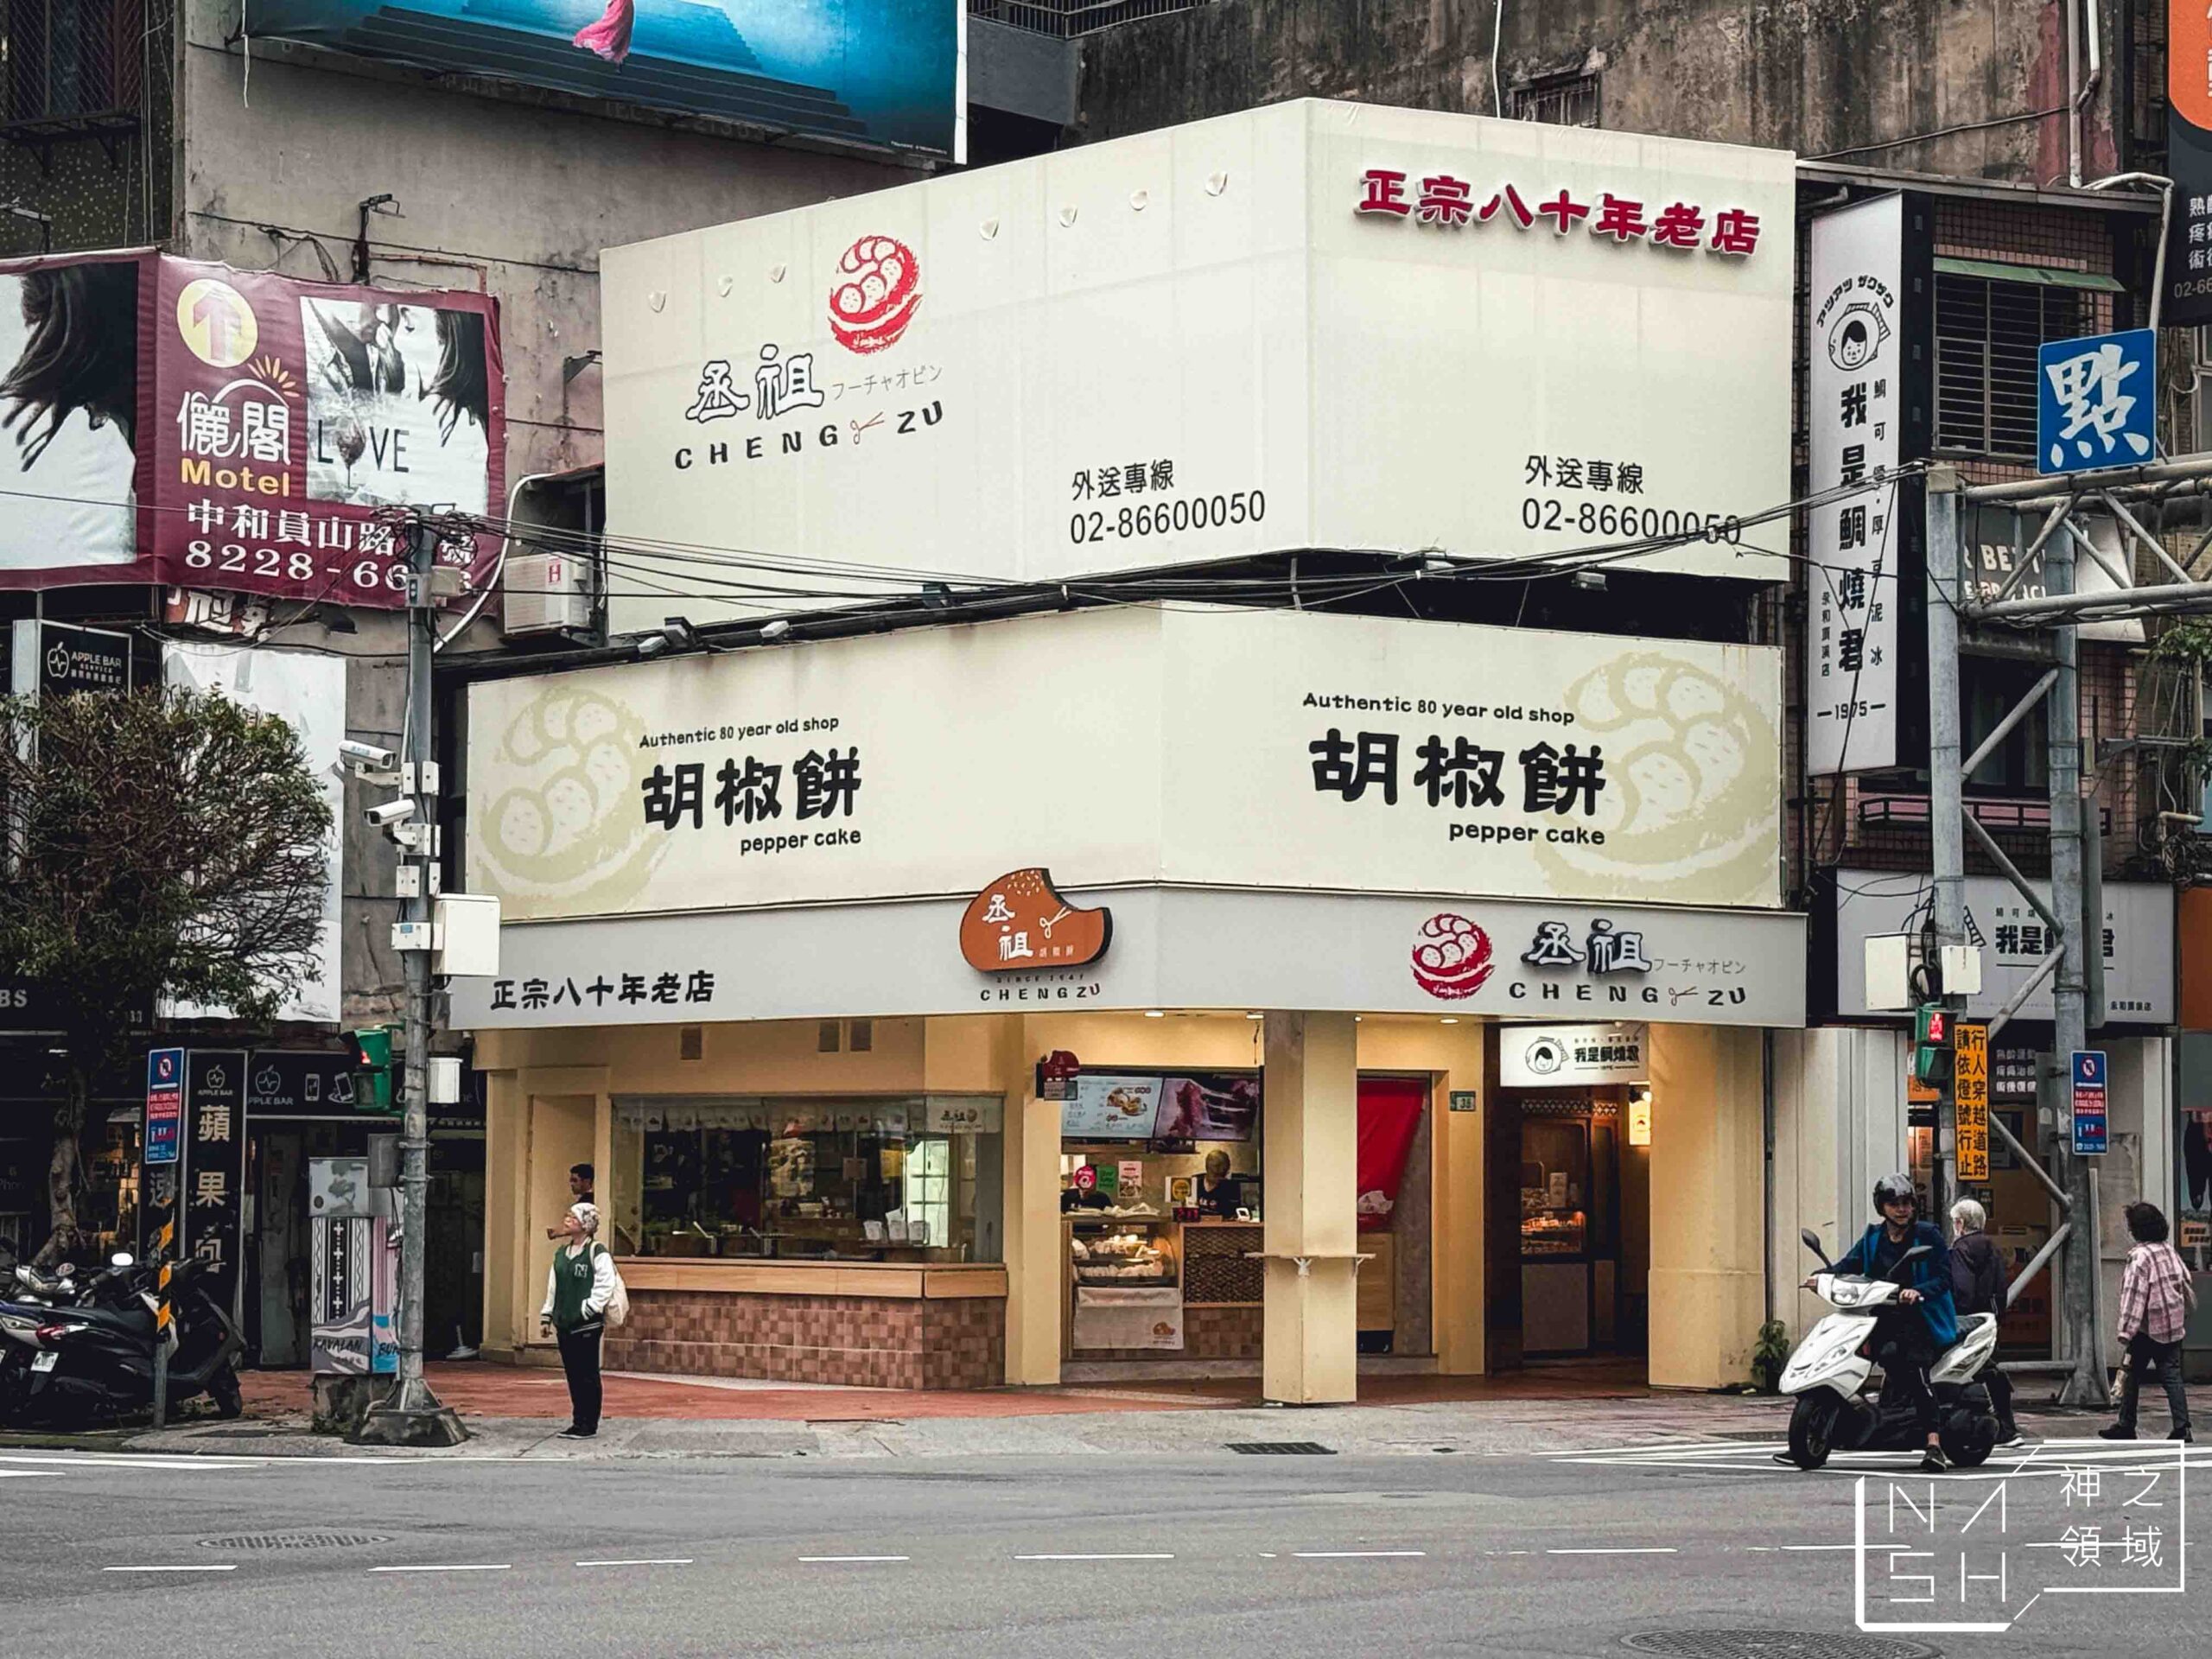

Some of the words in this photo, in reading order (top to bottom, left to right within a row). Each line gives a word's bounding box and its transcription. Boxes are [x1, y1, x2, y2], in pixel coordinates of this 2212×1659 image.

[1357, 169, 1761, 256] 正宗八十年老店
[685, 344, 824, 423] 丞祖
[2045, 344, 2150, 467] 點
[675, 425, 838, 469] CHENG
[897, 401, 943, 434] ZU
[181, 458, 289, 497] Motel
[1072, 459, 1174, 501] 外送專線
[1524, 454, 1644, 494] 外送專線
[1071, 490, 1265, 544] 02-86600050
[72, 652, 101, 664] APPLE
[103, 656, 122, 669] BAR
[1303, 692, 1412, 713] Authentic
[1417, 699, 1437, 714] 80
[1442, 702, 1488, 718] year
[1493, 705, 1523, 720] old
[1529, 707, 1575, 726] shop
[1835, 701, 1867, 720] 1975
[639, 728, 716, 748] Authentic
[720, 727, 734, 741] 80
[738, 723, 772, 741] year
[776, 720, 799, 734] old
[803, 716, 840, 736] shop
[641, 746, 862, 831] 胡椒餅
[1308, 728, 1607, 816] 胡椒餅
[741, 833, 810, 856] pepper
[814, 828, 861, 848] cake
[1449, 822, 1539, 843] pepper
[1546, 825, 1605, 845] cake
[1521, 918, 1652, 974] 丞祖
[490, 969, 715, 1012] 正宗八十年老店
[1509, 982, 1659, 1003] CHENG
[1707, 987, 1747, 1006] ZU
[274, 1096, 294, 1105] BAR
[1956, 1028, 1974, 1177] 請依燈號行止
[1971, 1029, 1987, 1177] 行人穿越道路
[313, 1338, 363, 1353] KAVALAN
